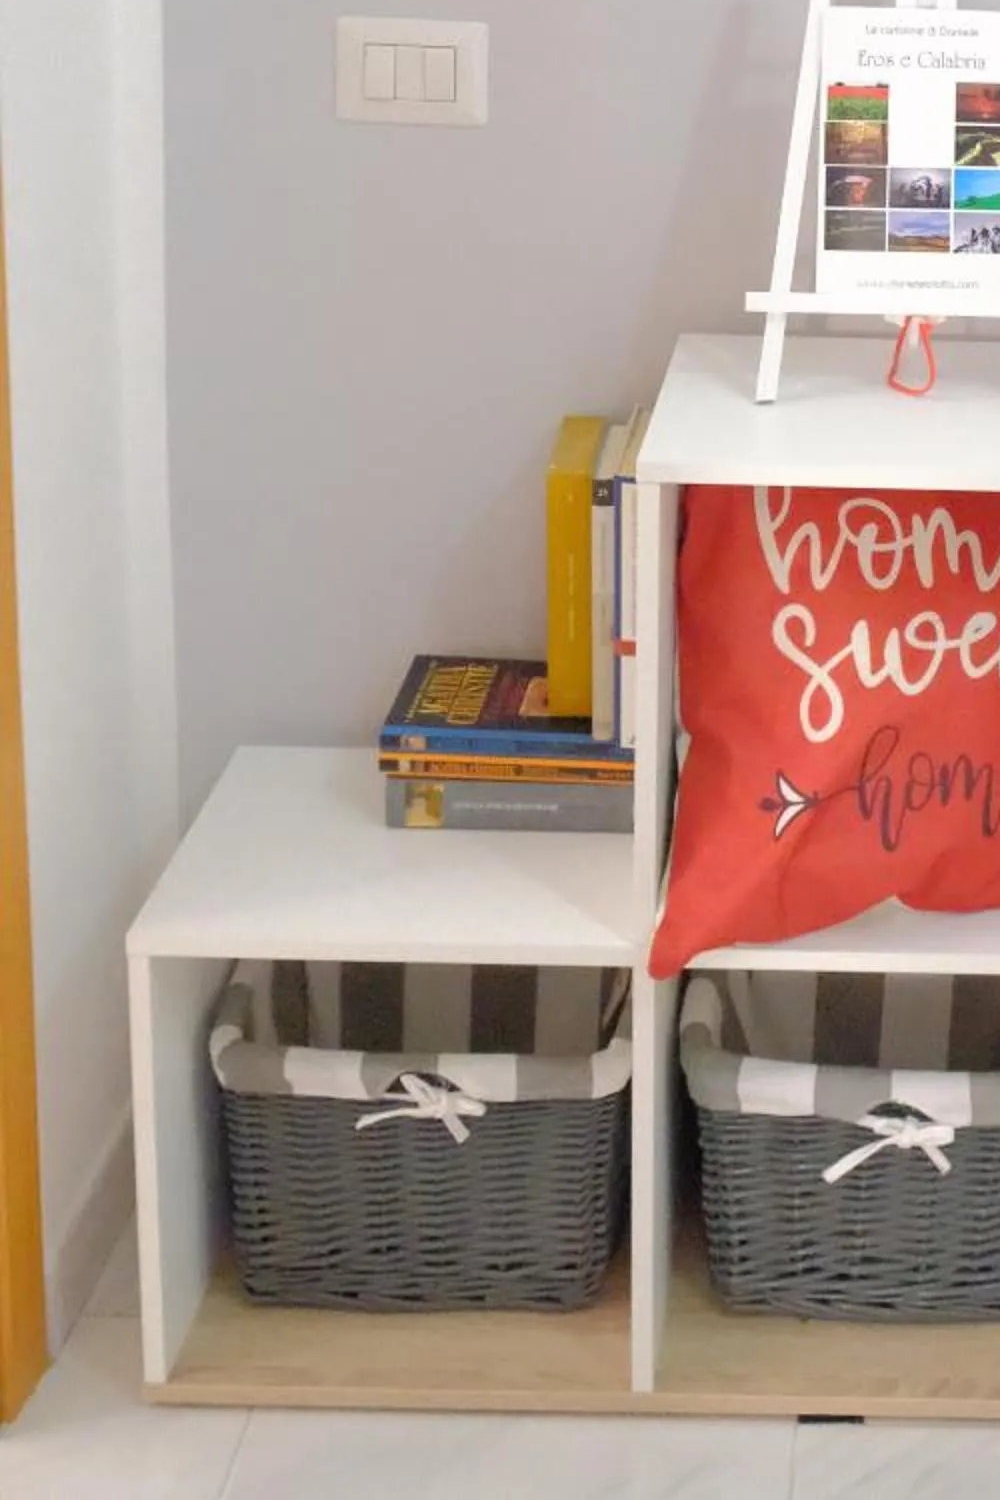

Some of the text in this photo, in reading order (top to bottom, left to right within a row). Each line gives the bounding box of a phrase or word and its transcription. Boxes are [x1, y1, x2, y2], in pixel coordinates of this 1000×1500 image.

[858, 49, 986, 70] Eros e Calabria
